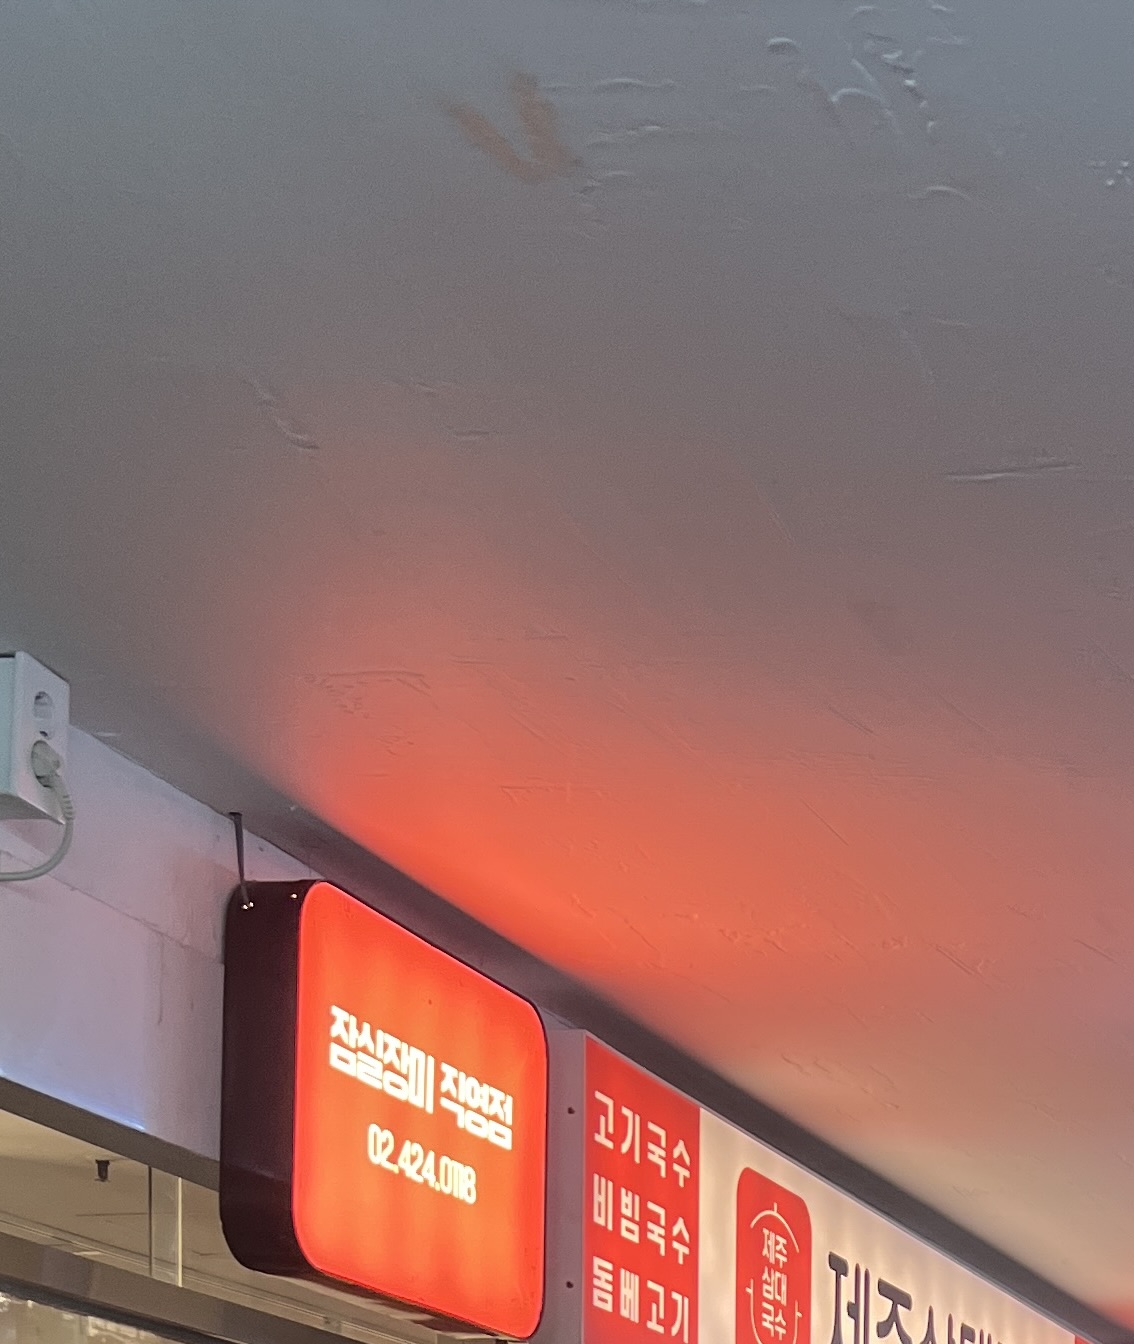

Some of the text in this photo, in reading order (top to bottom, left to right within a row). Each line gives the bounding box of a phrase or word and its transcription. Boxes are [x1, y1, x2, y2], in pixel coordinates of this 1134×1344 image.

[329, 1006, 513, 1151] 잠실장미 직영점
[367, 1124, 477, 1205] 02.424.0118
[594, 1092, 692, 1188] 고기국수
[593, 1174, 691, 1265] 비빔국수
[762, 1226, 788, 1269] 제주
[592, 1256, 689, 1344] 돔베고기
[761, 1303, 788, 1343] 국수
[762, 1269, 788, 1304] 삼대
